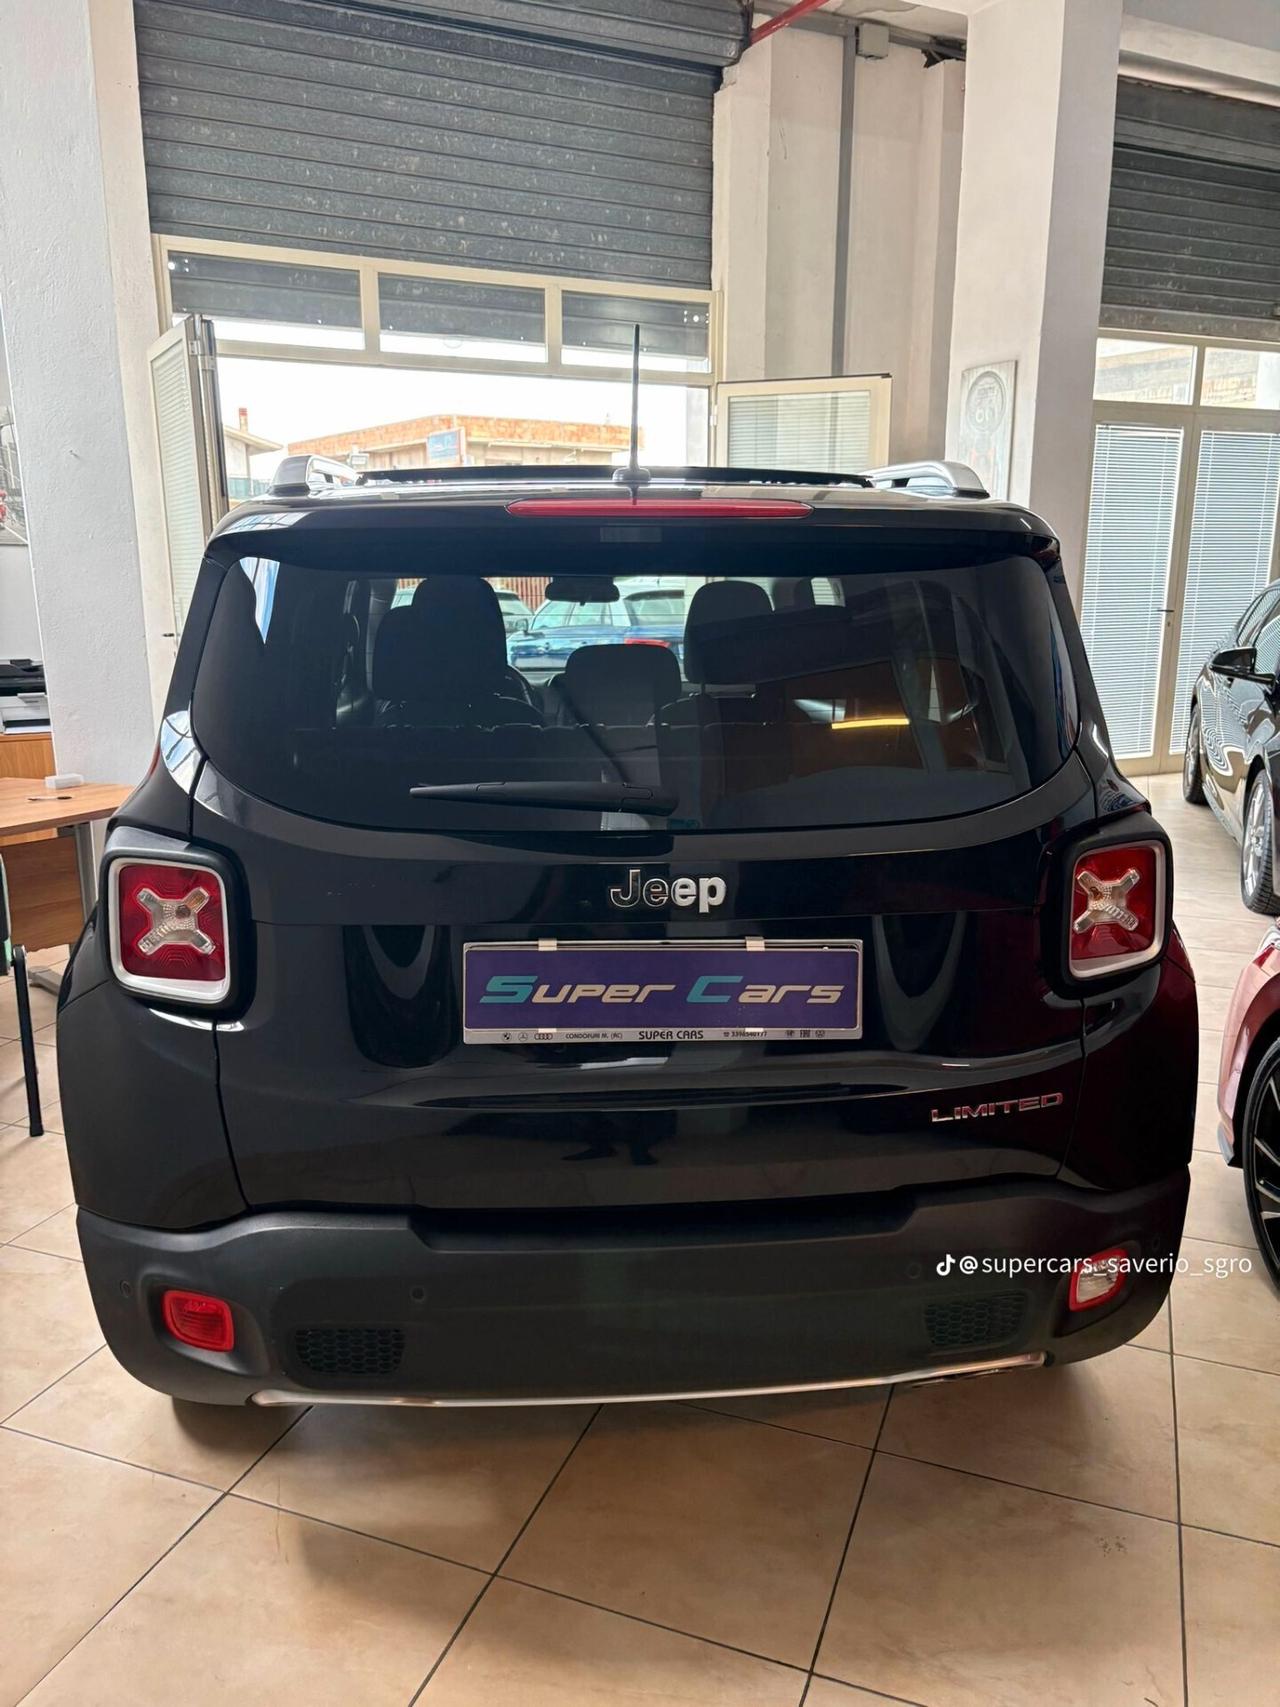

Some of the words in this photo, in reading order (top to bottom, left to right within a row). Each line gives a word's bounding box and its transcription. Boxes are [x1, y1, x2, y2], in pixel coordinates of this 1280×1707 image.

[610, 868, 727, 913] Jeep
[479, 974, 676, 1005] Super
[686, 974, 844, 1005] Cars
[638, 1030, 673, 1040] SUPER
[676, 1030, 704, 1040] CARS
[931, 1092, 1063, 1122] LIMITED
